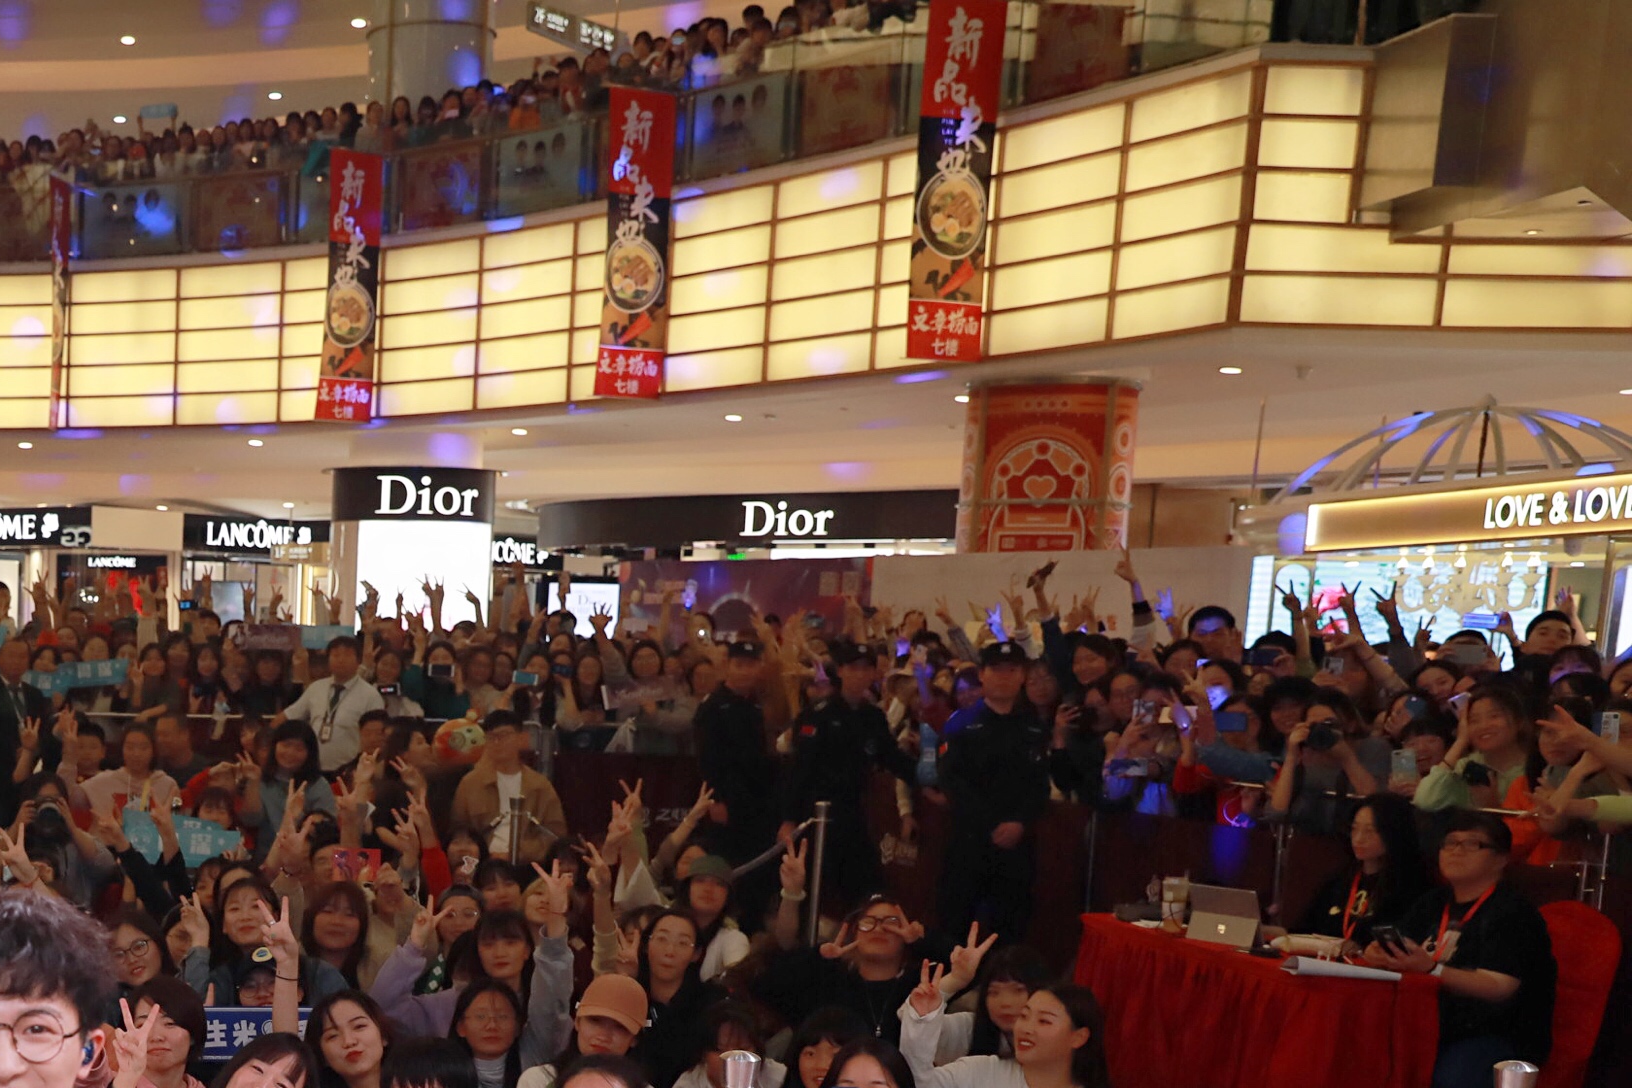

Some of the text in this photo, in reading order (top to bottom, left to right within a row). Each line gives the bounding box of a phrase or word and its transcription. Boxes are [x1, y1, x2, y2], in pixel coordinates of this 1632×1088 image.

[911, 305, 979, 335] 文章捞面
[374, 475, 479, 516] Dior
[1484, 493, 1545, 529] LOVE
[1549, 491, 1568, 525] &
[739, 500, 834, 536] Dior
[206, 519, 295, 549] LANCÔME
[88, 556, 136, 568] LANCÔME
[204, 1019, 257, 1048] 生米
